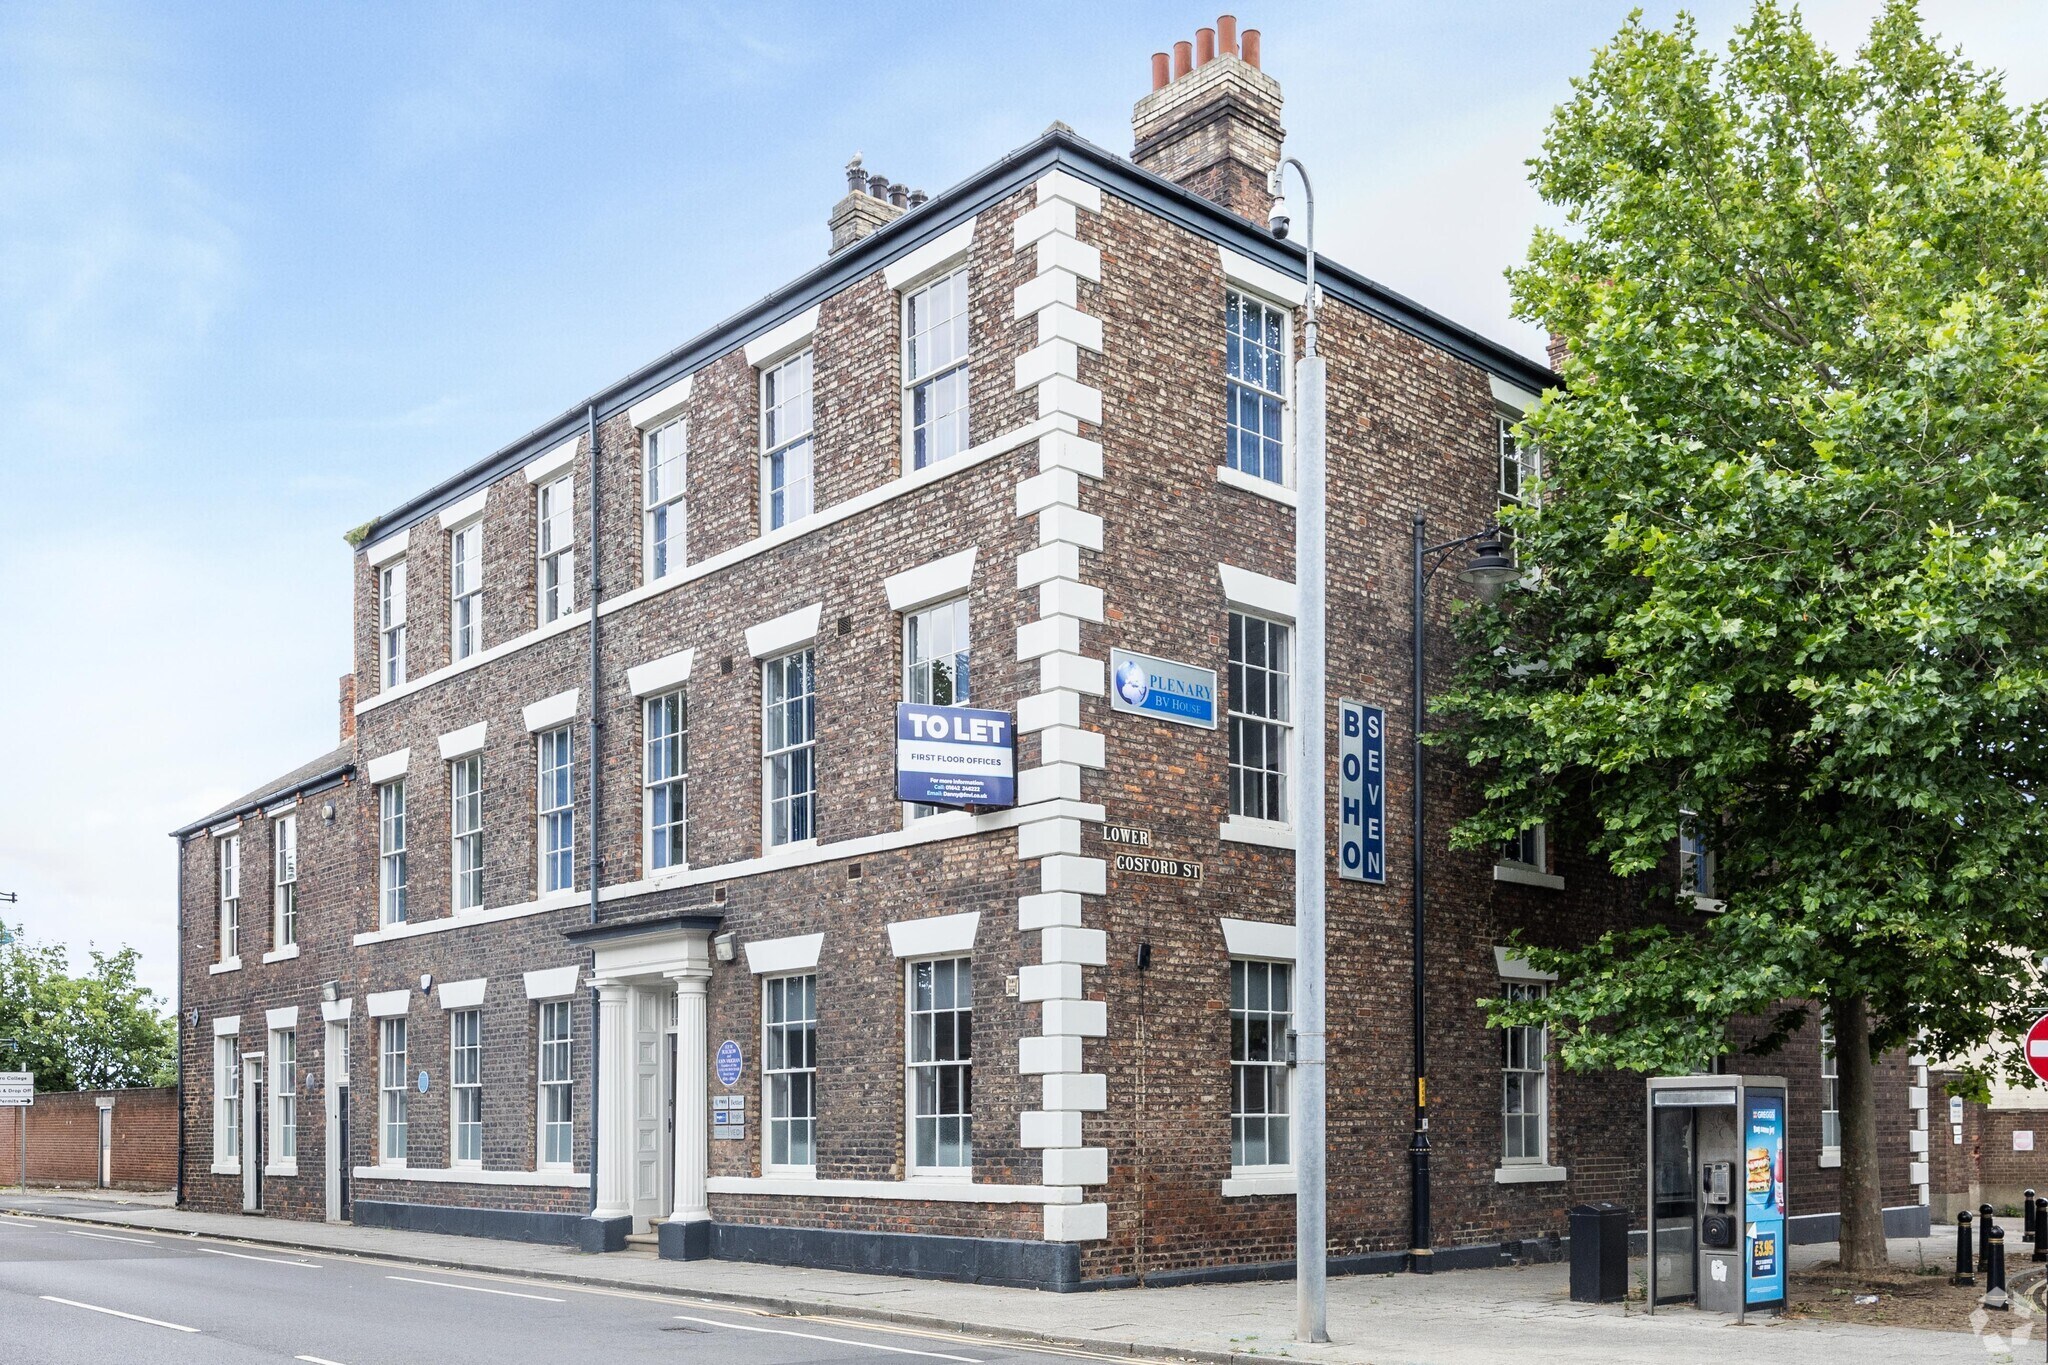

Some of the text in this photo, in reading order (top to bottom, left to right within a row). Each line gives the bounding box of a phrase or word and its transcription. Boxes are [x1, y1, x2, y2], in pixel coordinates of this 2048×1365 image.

[1150, 674, 1213, 700] PLENARY
[1155, 695, 1169, 707] BV
[908, 713, 1005, 743] TO LET
[911, 753, 1002, 766] FIRST FLOOR OFFICES
[1343, 708, 1361, 870] BOHO
[1367, 715, 1381, 875] SEVEN
[1103, 826, 1149, 845] LOWER
[1116, 855, 1200, 878] GOSFORD ST
[1758, 1111, 1775, 1119] GREGGS
[1755, 1240, 1774, 1257] £3.95
